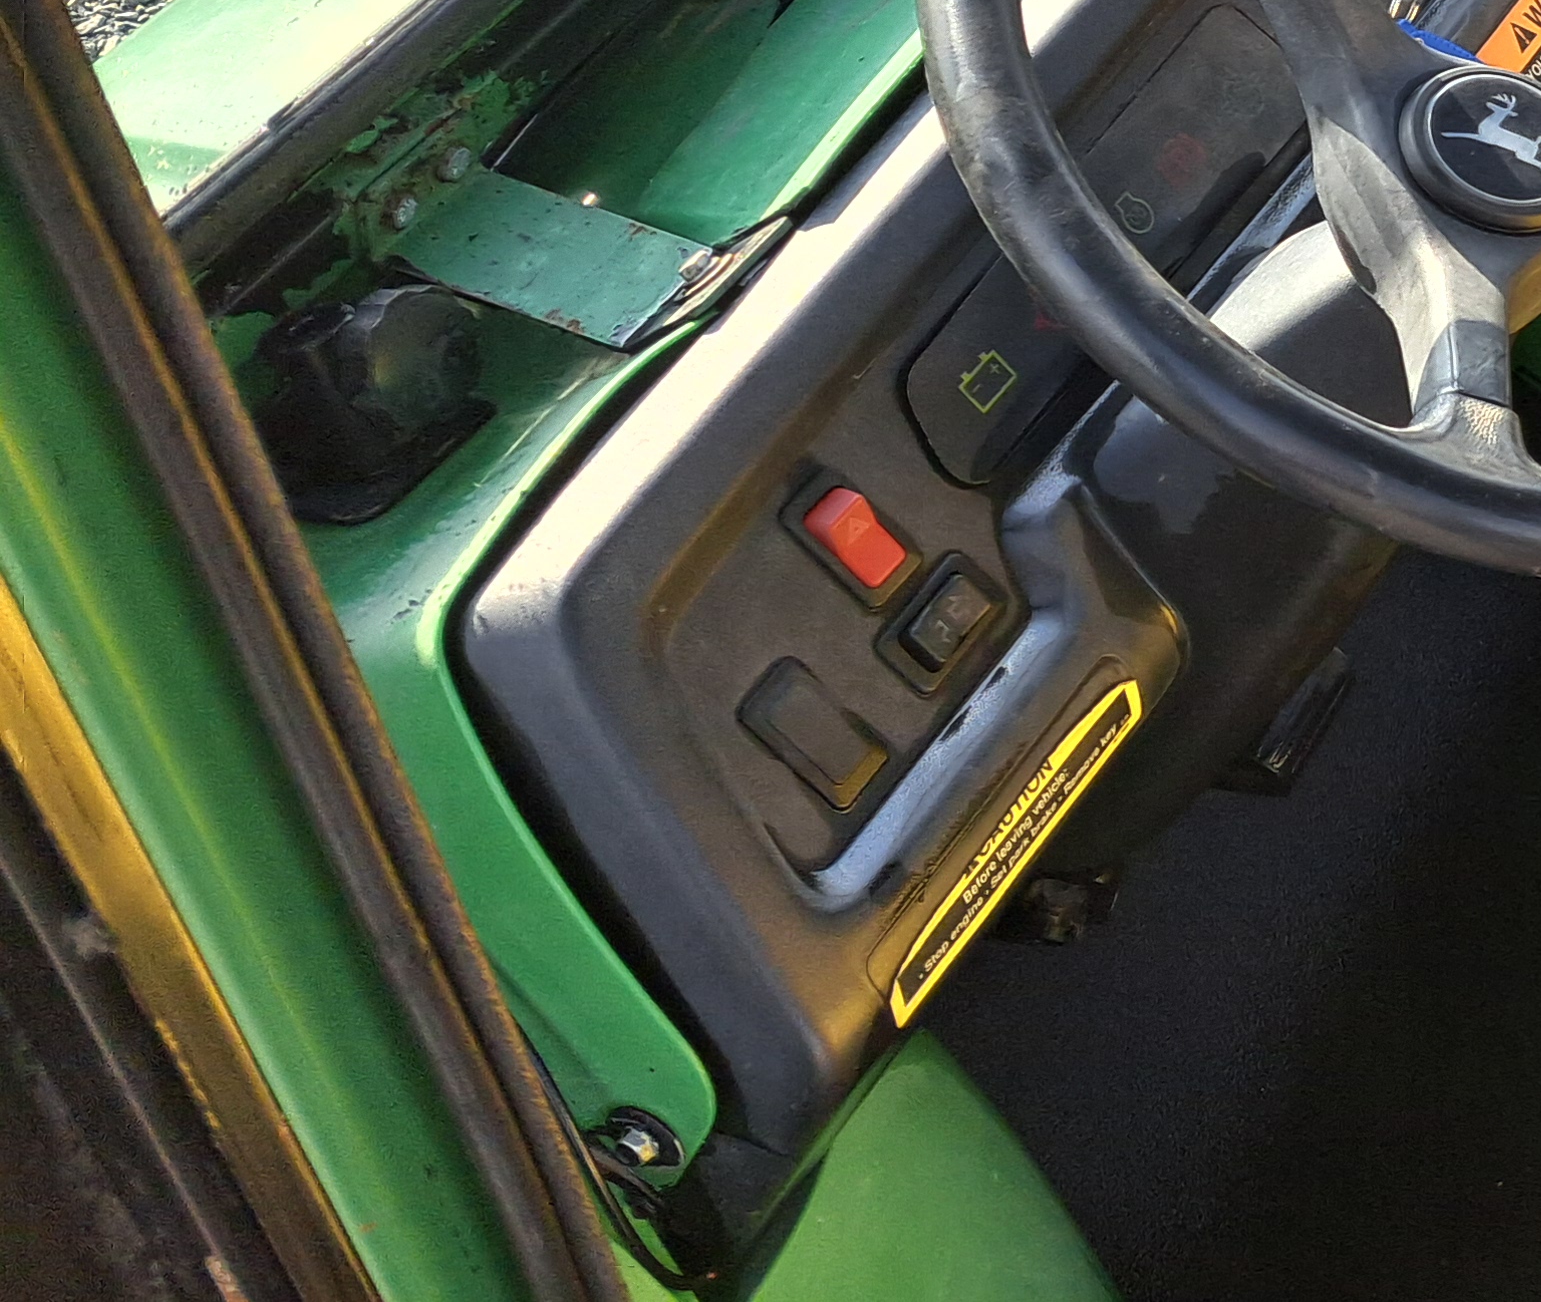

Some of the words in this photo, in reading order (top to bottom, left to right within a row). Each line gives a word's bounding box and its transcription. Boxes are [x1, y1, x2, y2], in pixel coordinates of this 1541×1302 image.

[924, 941, 949, 972] Stop
[950, 896, 983, 941] engine
[990, 865, 1007, 889] Set
[1008, 838, 1030, 871] park
[1030, 804, 1057, 838] brake
[1063, 748, 1100, 796] Remove
[1101, 724, 1118, 747] key
[963, 860, 997, 904] Before
[997, 815, 1032, 862] leaving
[1032, 767, 1071, 816] vehicle:
